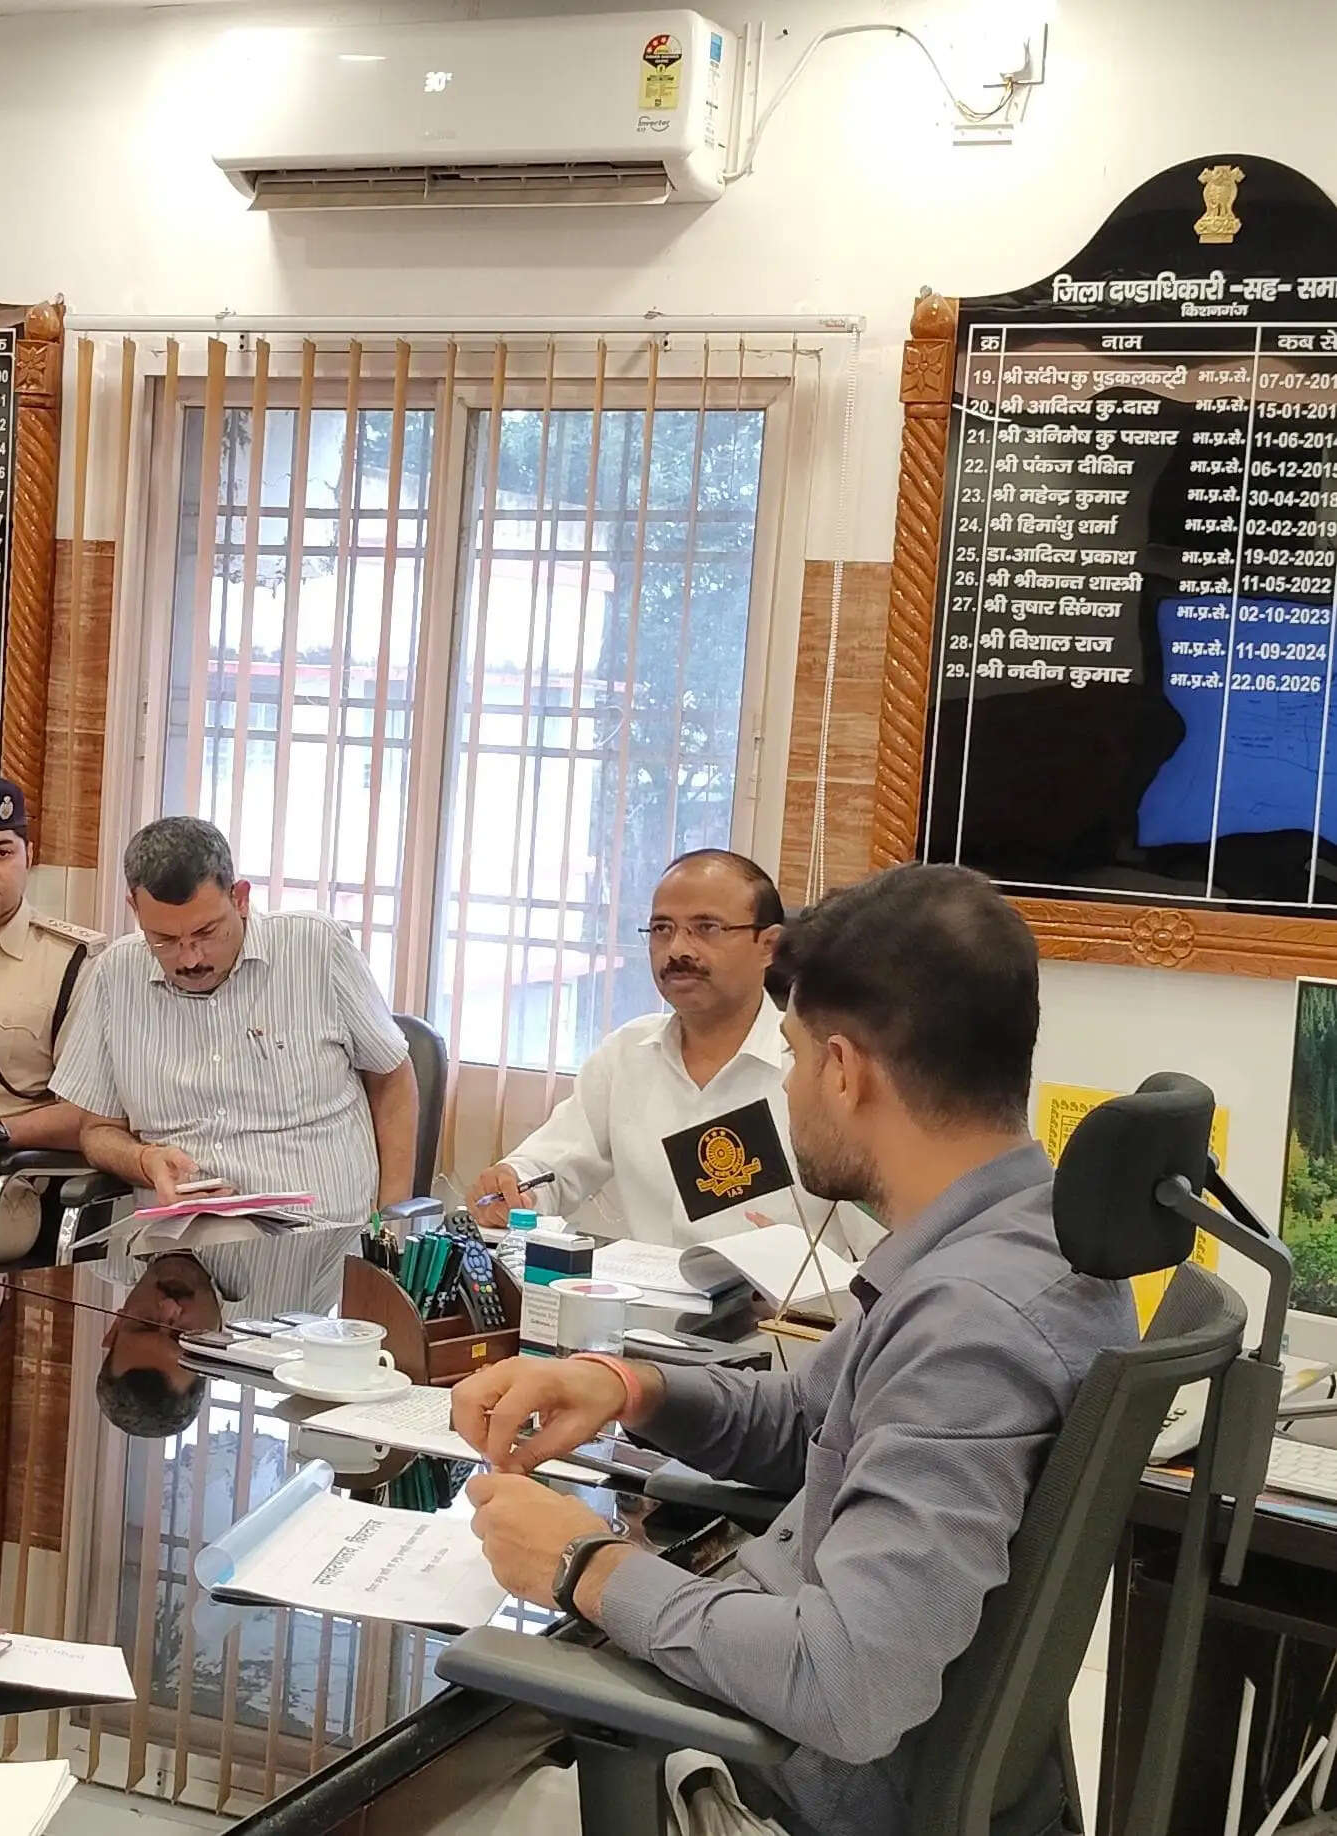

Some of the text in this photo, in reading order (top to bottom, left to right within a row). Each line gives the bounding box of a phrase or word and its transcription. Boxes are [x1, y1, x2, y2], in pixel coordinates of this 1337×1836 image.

[1053, 274, 1105, 302] जिला
[1109, 270, 1225, 303] दण्डाधिकारी
[1181, 302, 1249, 317] किशनगंज
[981, 335, 1000, 351] क्र
[1102, 335, 1143, 349] नाम
[1278, 335, 1315, 350] कब
[974, 370, 995, 385] 19.
[1260, 373, 1337, 389] 07-07-201
[1000, 395, 1023, 414] श्री
[1027, 395, 1090, 415] आदित्य
[1257, 402, 1336, 419] 15-01-201
[966, 429, 990, 444] 21.
[998, 424, 1020, 444] श्री
[1024, 425, 1092, 444] अनिमेष
[1120, 430, 1180, 445] पराशर
[964, 459, 988, 473] 22.
[995, 454, 1018, 473] श्री
[1023, 456, 1074, 474] पंकज
[1078, 455, 1134, 475] दीक्षित
[961, 489, 985, 503] 23.
[993, 484, 1016, 503] श्री
[1019, 485, 1072, 506] महेन्द्र
[1075, 489, 1129, 510] कुमार
[959, 518, 982, 532] 24.
[990, 513, 1014, 532] श्री
[1017, 513, 1074, 540] हिमांशु
[1078, 515, 1119, 535] शर्मा
[1246, 520, 1336, 537] 02-02-2019
[956, 548, 979, 562] 25.
[1080, 549, 1137, 566] प्रकाश
[1244, 549, 1334, 566] 19-02-2020
[955, 572, 978, 586] 26.
[987, 568, 1010, 588] श्री
[1014, 569, 1085, 590] श्रीकान्त
[1089, 572, 1143, 592] शास्त्री
[1241, 575, 1332, 594] 11-05-2022
[952, 597, 976, 611] 27.
[984, 594, 1007, 613] श्री
[1011, 599, 1056, 620] तुषार
[1059, 596, 1122, 618] सिंगला
[1238, 606, 1330, 624] 02-10-2023
[949, 635, 972, 649] 28.
[980, 628, 1005, 649] श्री
[1009, 629, 1072, 651] विशाल
[1075, 636, 1114, 652] राज
[1236, 643, 1326, 661] 11-09-2024
[946, 664, 969, 677] 29.
[976, 658, 1004, 679] श्री
[1008, 660, 1065, 680] नवीन
[1069, 666, 1132, 688] कुमार
[1231, 674, 1320, 692] 22.06.2026
[727, 1187, 744, 1198] IAS
